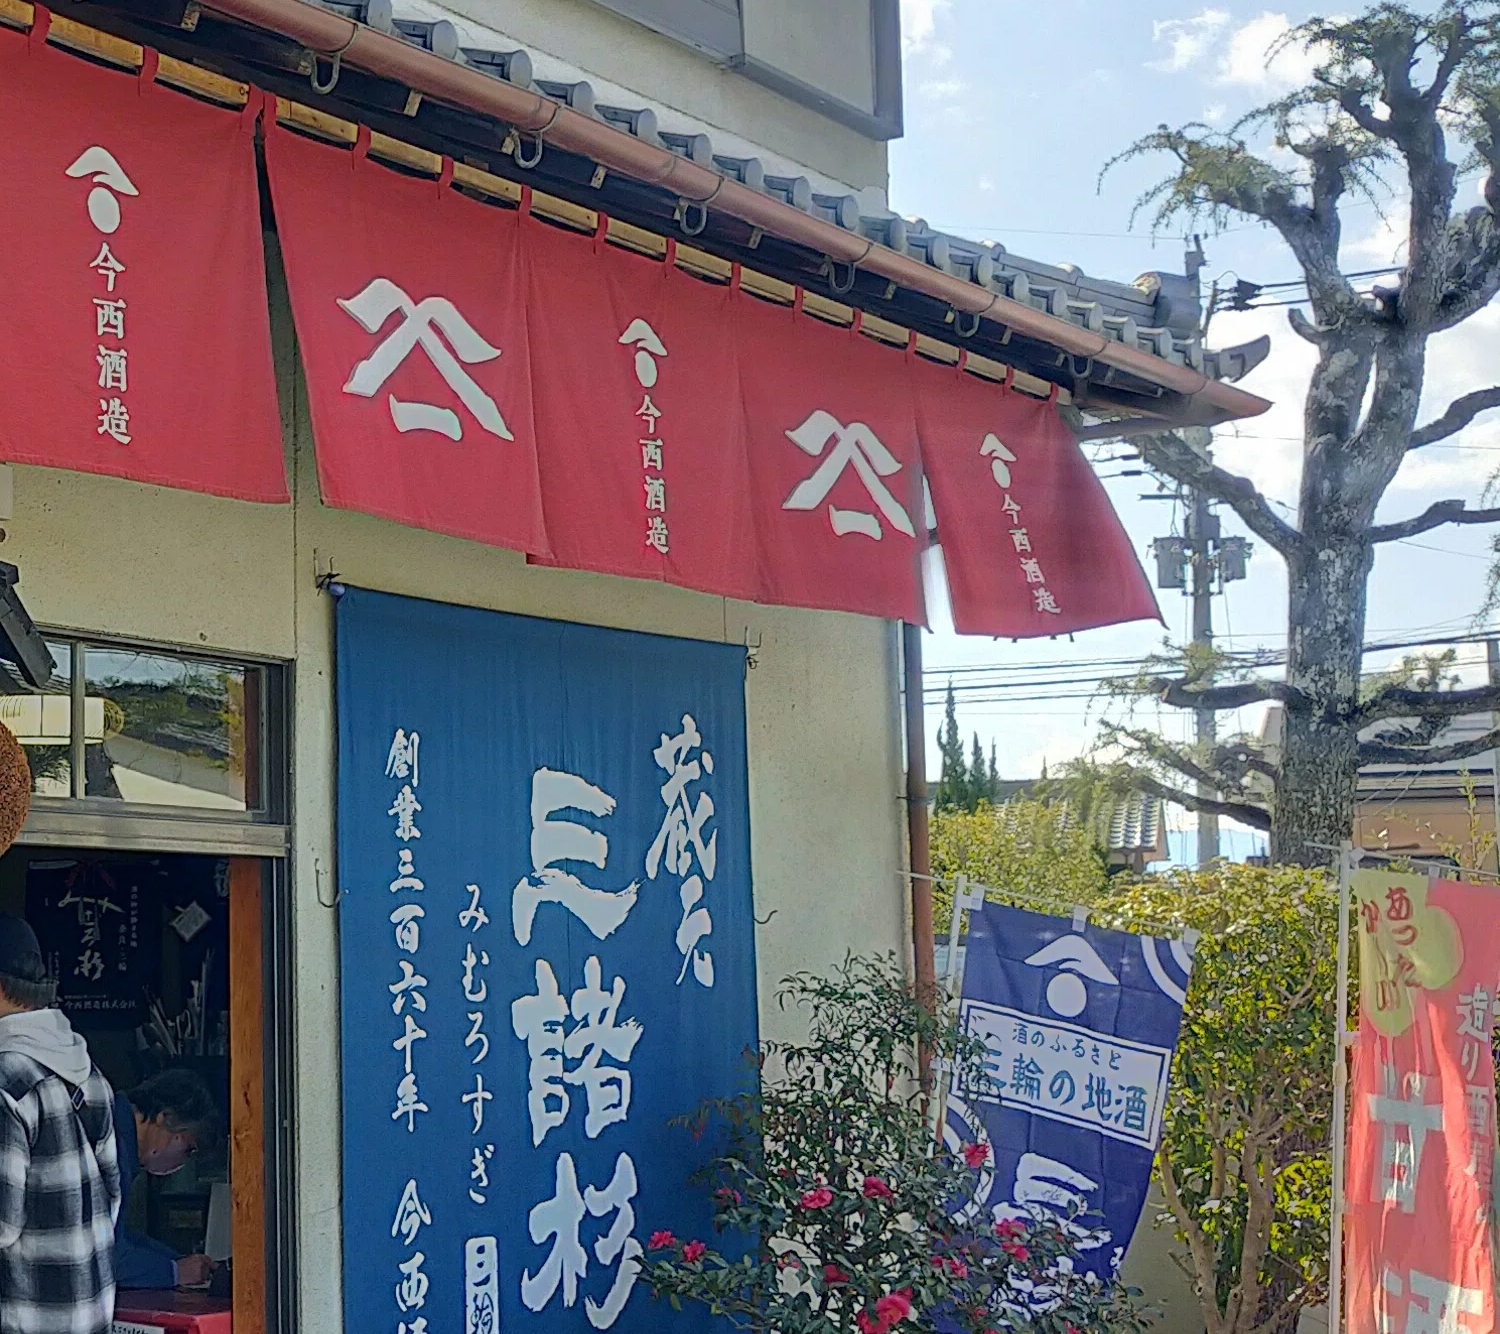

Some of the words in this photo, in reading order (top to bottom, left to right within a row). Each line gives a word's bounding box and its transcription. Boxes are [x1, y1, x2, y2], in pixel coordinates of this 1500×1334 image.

[89, 242, 132, 445] 今西酒造
[635, 394, 670, 554] 今西酒造
[1000, 493, 1062, 615] 今西酒造
[385, 728, 429, 1133] 創業三百六十年
[646, 713, 716, 987] 蔵元
[459, 884, 496, 1204] みむろすぎ
[511, 766, 646, 1329] 三諸杉
[1012, 1022, 1122, 1071] 酒のふるさと
